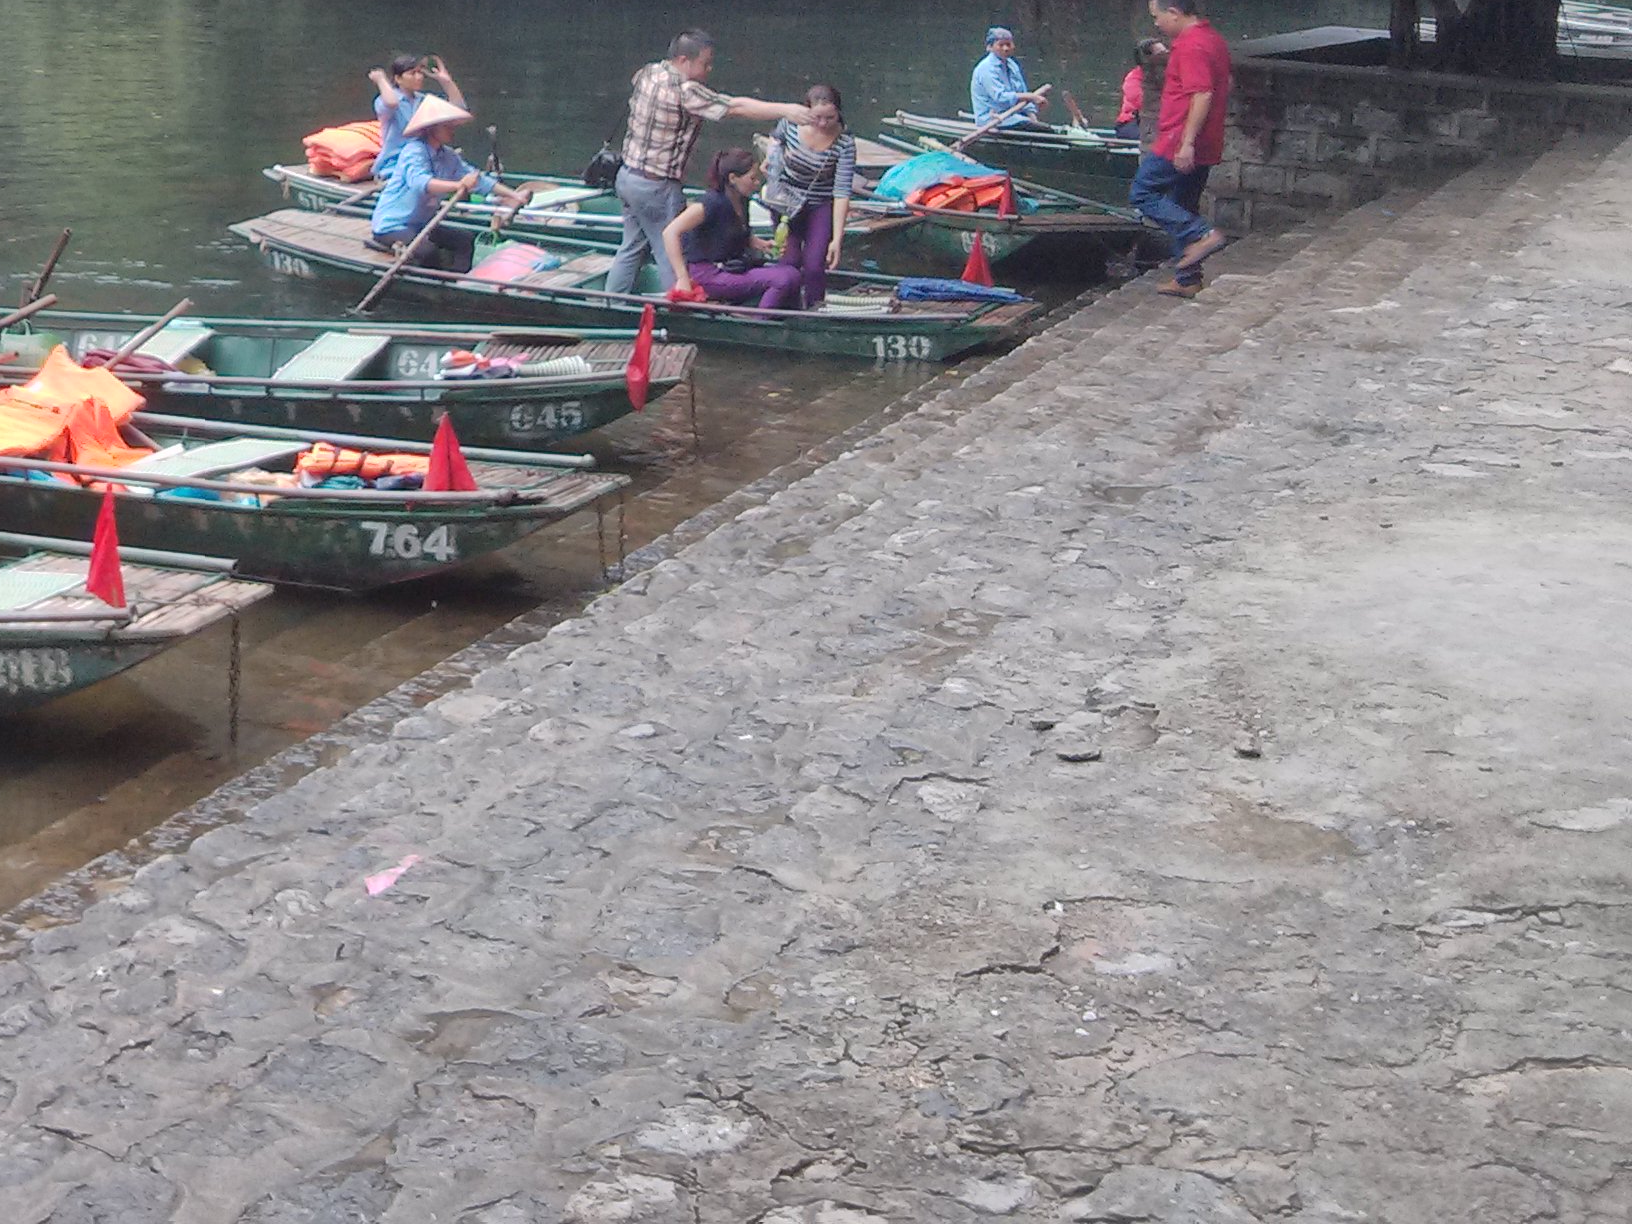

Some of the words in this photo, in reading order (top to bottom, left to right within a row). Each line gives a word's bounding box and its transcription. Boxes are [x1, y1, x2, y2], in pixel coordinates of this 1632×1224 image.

[872, 335, 930, 358] 130
[397, 349, 439, 378] 64
[361, 521, 455, 561] 764
